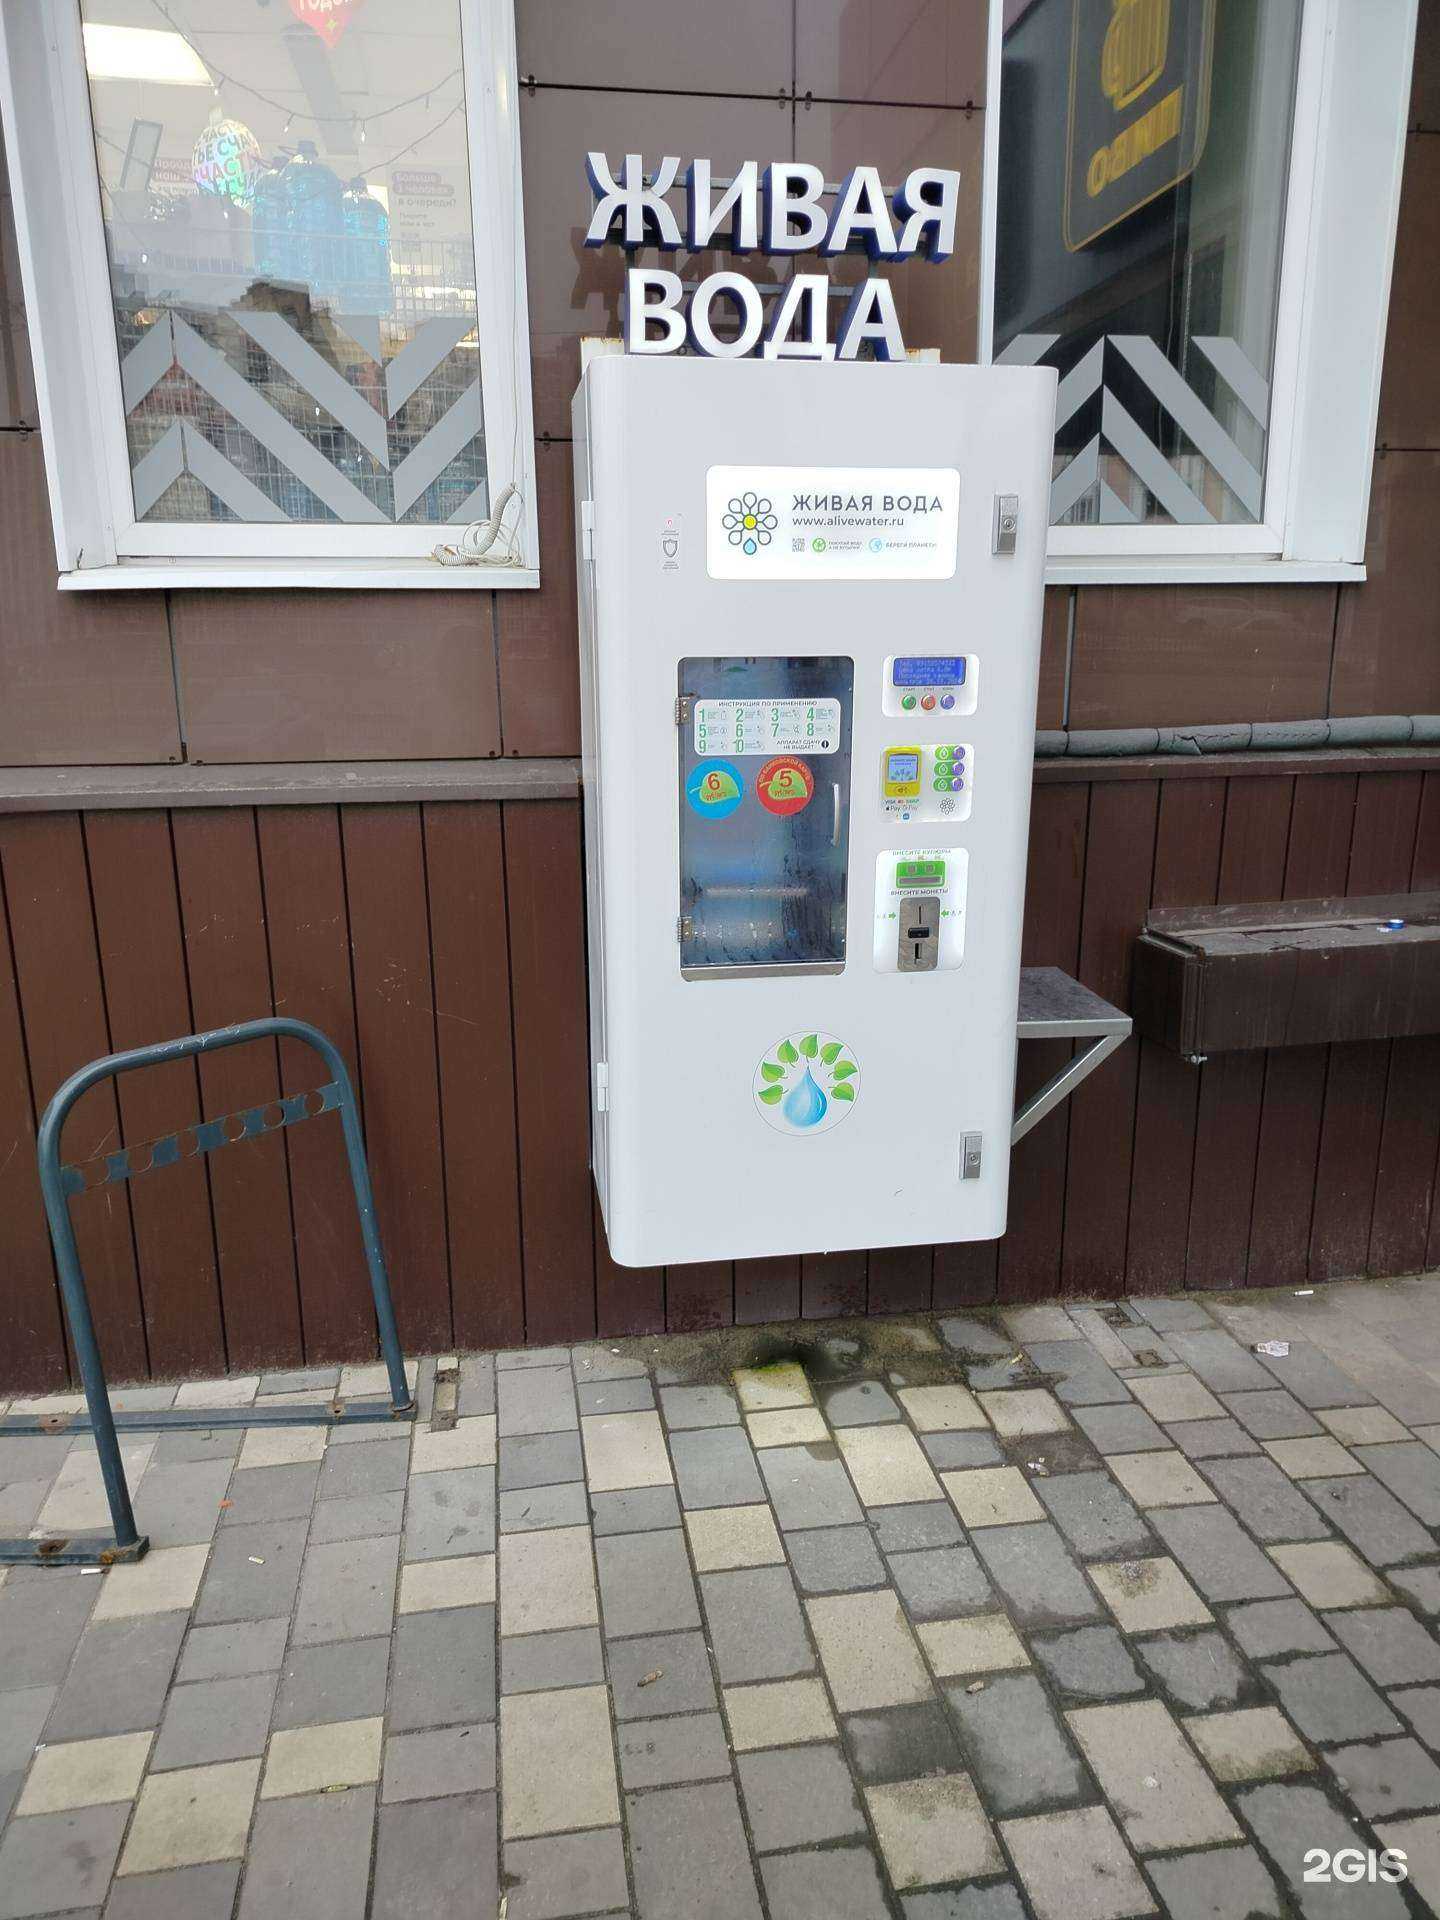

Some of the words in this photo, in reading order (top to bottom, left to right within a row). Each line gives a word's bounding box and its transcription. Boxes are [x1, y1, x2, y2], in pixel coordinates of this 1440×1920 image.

[584, 151, 961, 261] ЖИВАЯ
[625, 267, 907, 361] ВОДА
[792, 494, 873, 511] ЖИВАЯ
[883, 494, 943, 514] ВОДА
[792, 514, 904, 527] www.alivewater.ru
[699, 709, 705, 722] 1
[735, 709, 744, 722] 2
[771, 708, 779, 722] 3
[806, 707, 815, 721] 4
[699, 724, 707, 738] 5
[735, 724, 743, 738] 6
[771, 723, 780, 737] 7
[806, 723, 814, 736] 8
[699, 740, 706, 753] 9
[732, 740, 744, 753] 10
[707, 773, 720, 791] 6
[780, 770, 793, 788] 5
